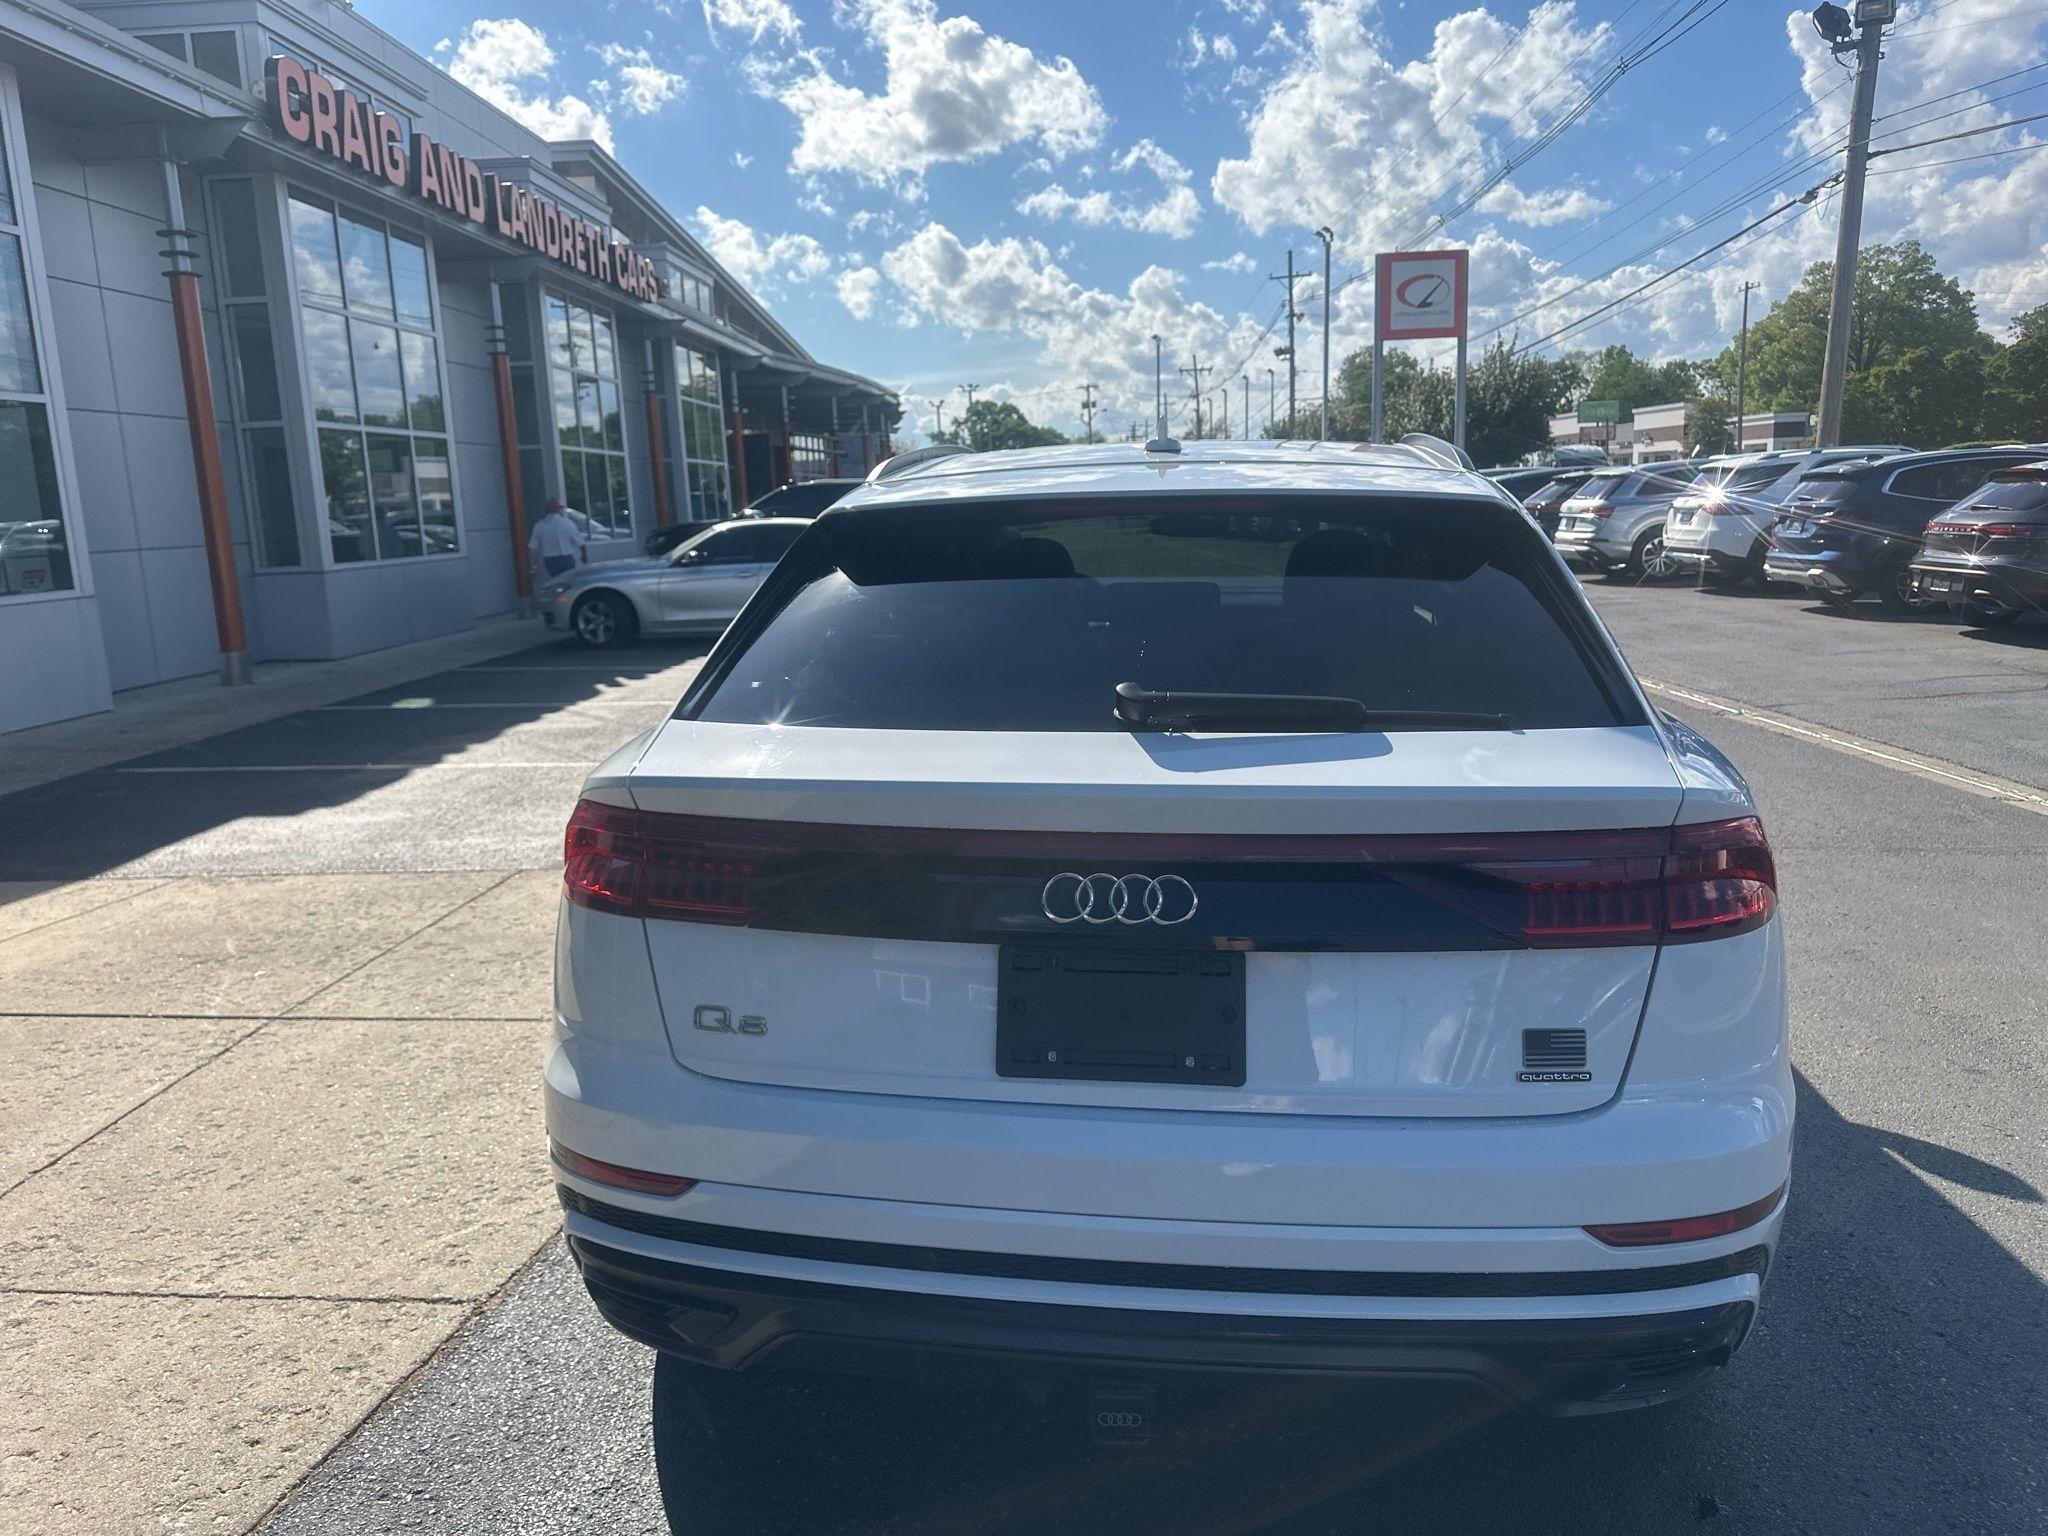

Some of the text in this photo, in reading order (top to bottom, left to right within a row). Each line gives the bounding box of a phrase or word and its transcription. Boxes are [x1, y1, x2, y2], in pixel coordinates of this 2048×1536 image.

[272, 57, 659, 304] CRAIG AND LANDRETH CARS
[693, 1004, 768, 1036] Q8
[1521, 1072, 1590, 1083] quattro
